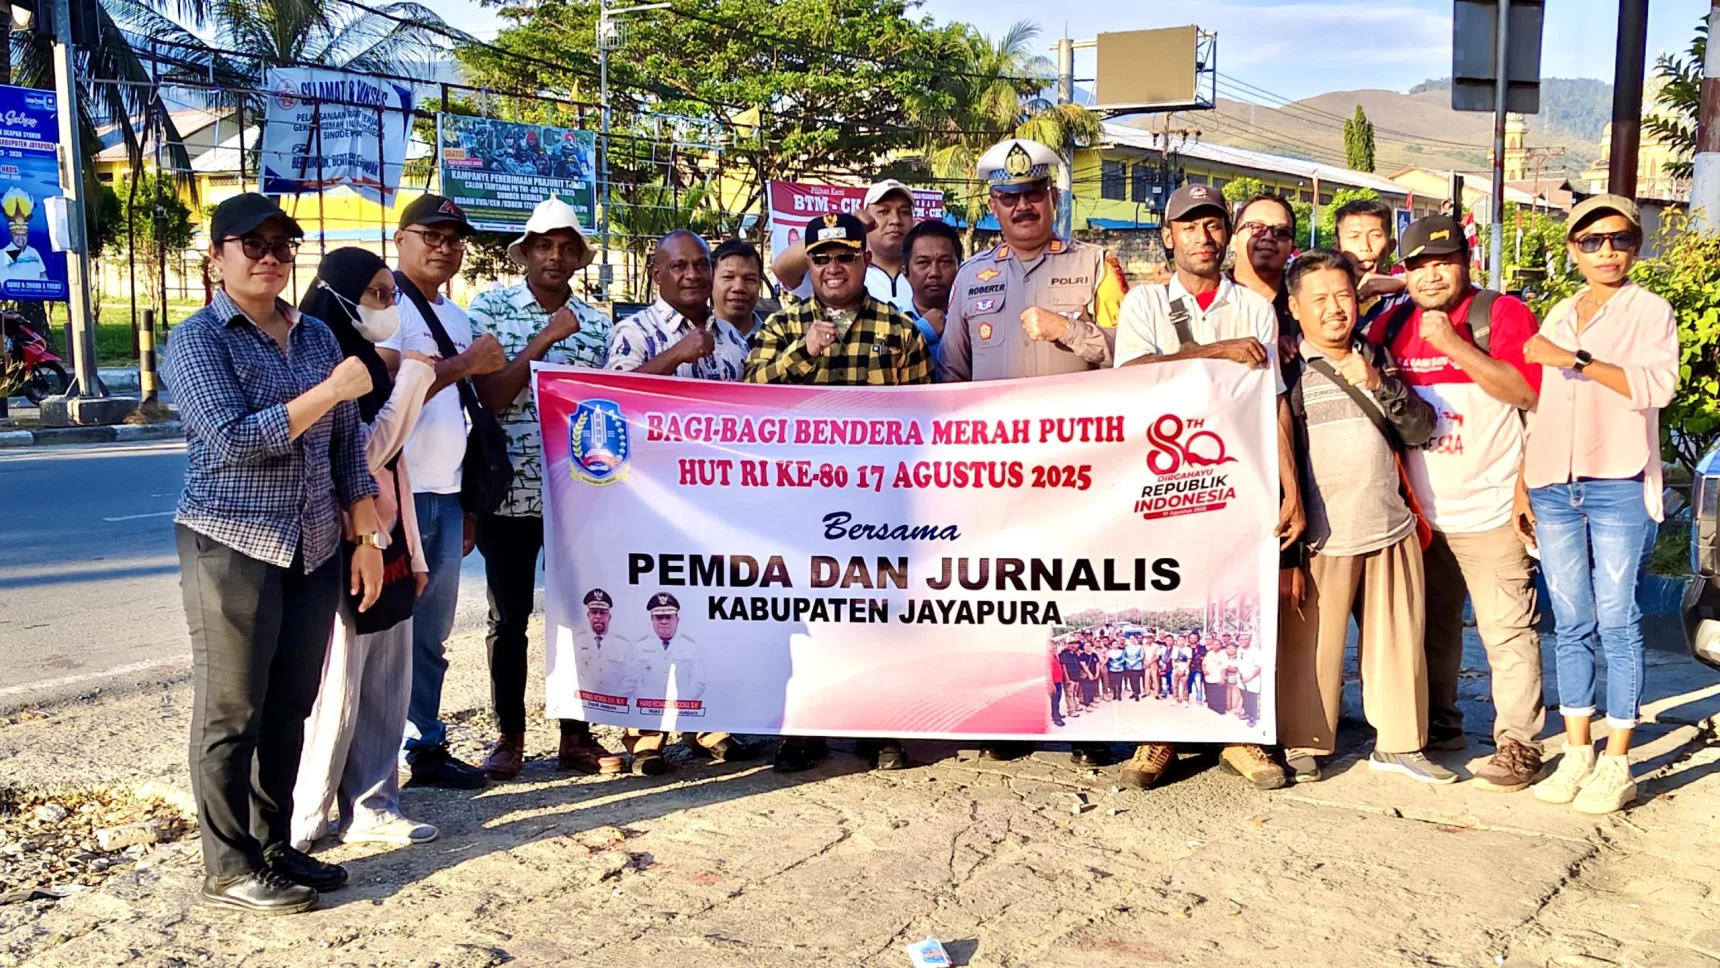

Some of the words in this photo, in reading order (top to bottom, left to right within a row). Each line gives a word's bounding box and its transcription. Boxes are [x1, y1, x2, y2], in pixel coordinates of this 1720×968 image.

[296, 111, 346, 122] PELASANAAN
[451, 170, 490, 182] KAMPANYE
[490, 173, 533, 186] PENERIMAAN
[831, 187, 845, 196] Kami
[793, 194, 829, 212] BTM
[841, 197, 862, 214] CK
[1051, 276, 1088, 286] POLRI
[646, 415, 787, 444] BAGI-BAGI
[793, 418, 924, 446] BENDERA
[931, 418, 1031, 446] MERAH
[1039, 415, 1125, 443] PUTIH
[1186, 418, 1205, 429] TH
[678, 458, 733, 487] HUT
[740, 459, 769, 488] RI
[776, 460, 849, 489] KE-80
[856, 464, 885, 493] 17
[892, 461, 1024, 489] AGUSTUS
[1031, 464, 1092, 491] 2025
[1141, 474, 1229, 498] REPUBLIK
[1157, 468, 1214, 483] DIRGAHAYU
[1133, 486, 1236, 513] INDONESIA
[822, 510, 962, 541] Bersama
[628, 552, 793, 589] PEMDA
[810, 555, 908, 590] DAN
[926, 556, 1181, 592] JURNALIS
[708, 595, 889, 624] KABUPATEN
[898, 598, 1063, 625] JAYAPURA
